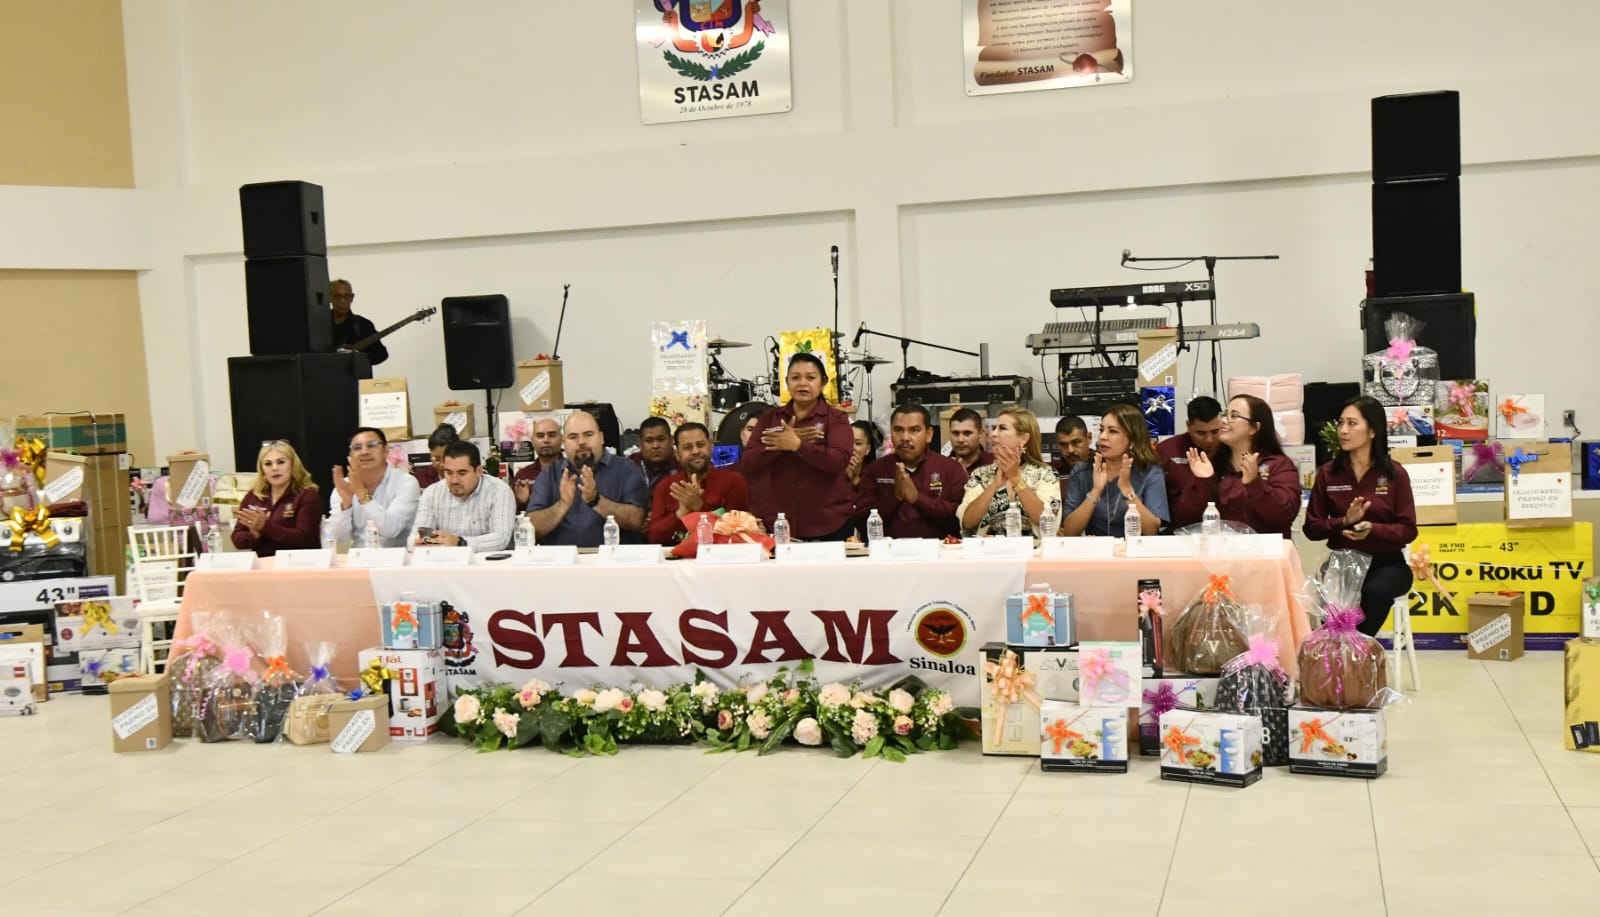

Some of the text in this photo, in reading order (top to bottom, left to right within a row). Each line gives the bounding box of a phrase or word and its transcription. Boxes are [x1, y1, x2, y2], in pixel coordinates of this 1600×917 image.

[1017, 65, 1055, 76] STASAM
[674, 80, 759, 104] STASAM
[1142, 285, 1165, 294] KORG
[1116, 332, 1138, 342] KOR
[1218, 328, 1246, 337] N264
[1437, 429, 1447, 437] 12
[1499, 541, 1519, 552] 43"
[1480, 561, 1543, 580] Roku
[1549, 561, 1584, 579] TV
[36, 586, 75, 604] 43"
[1408, 591, 1460, 616] 2K
[487, 609, 904, 670] STASAM
[909, 656, 976, 676] Sinaloa
